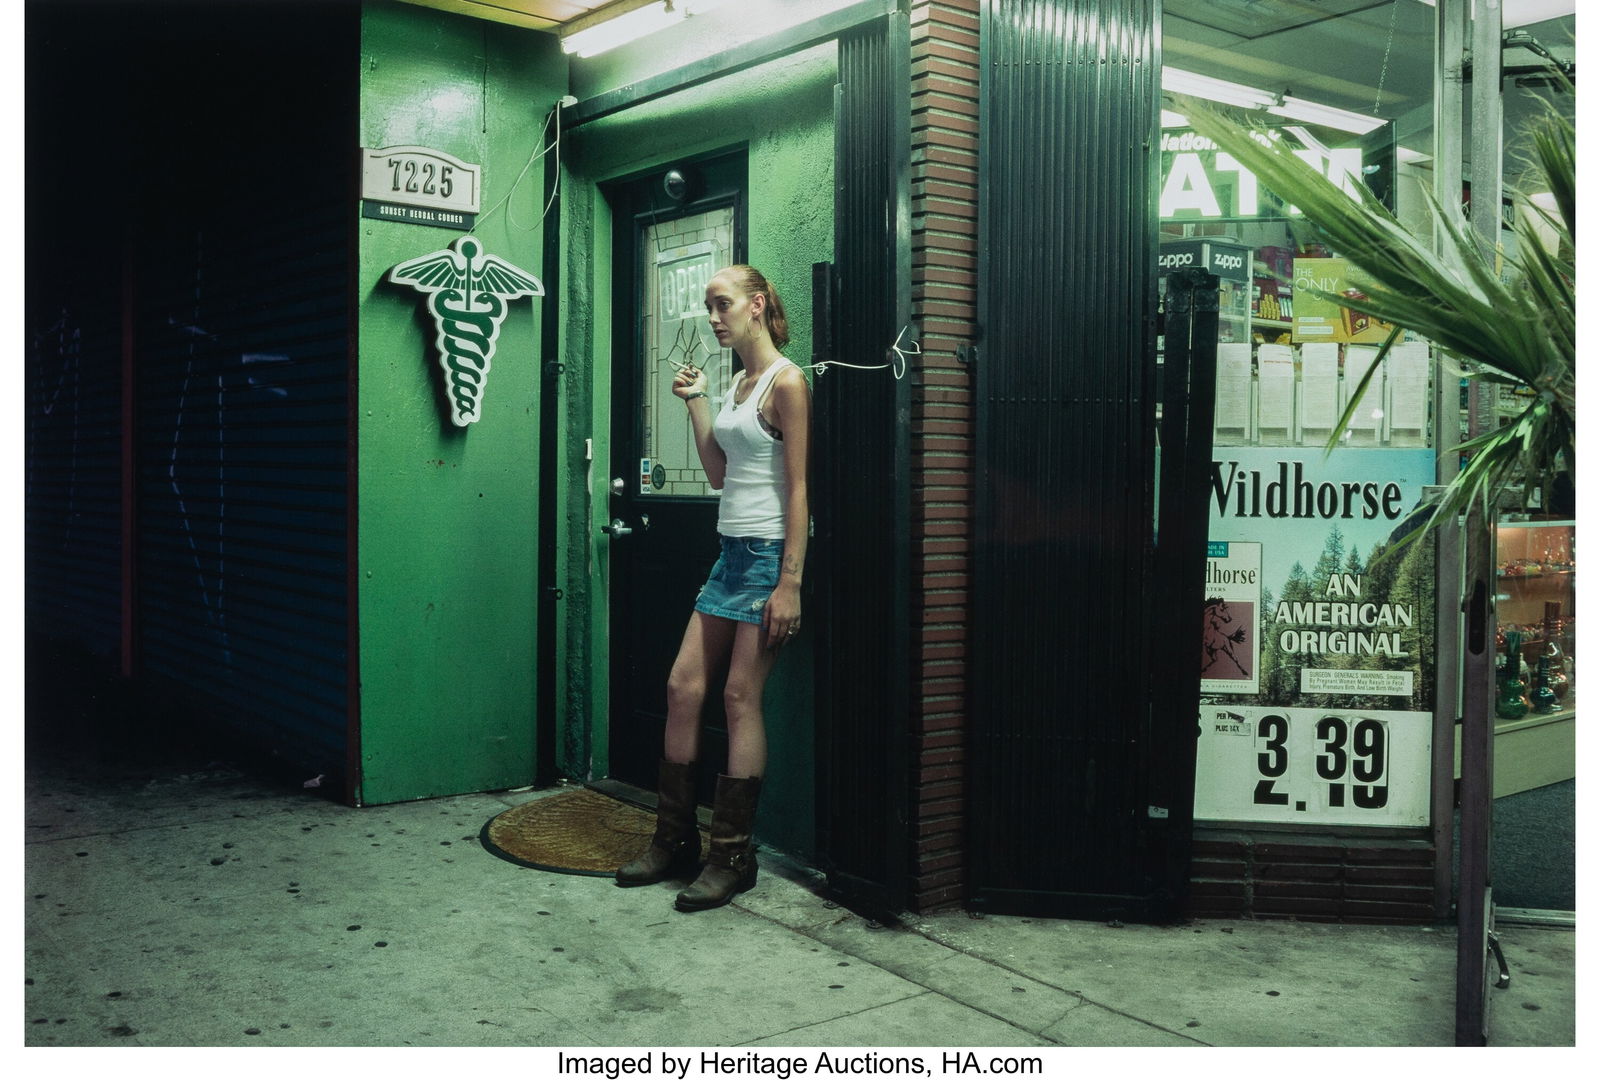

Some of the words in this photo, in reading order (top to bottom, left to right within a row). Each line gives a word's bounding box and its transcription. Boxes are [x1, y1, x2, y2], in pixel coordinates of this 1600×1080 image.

[388, 158, 453, 198] 7225
[380, 206, 406, 217] SUNSET
[410, 209, 435, 220] HERBAL
[438, 213, 463, 224] CORNER
[1296, 267, 1313, 277] THE
[1296, 278, 1339, 292] ONLY
[1325, 573, 1361, 597] AN
[1275, 601, 1413, 627] AMERICAN
[1279, 630, 1409, 656] ORIGINAL
[1216, 712, 1227, 720] PER
